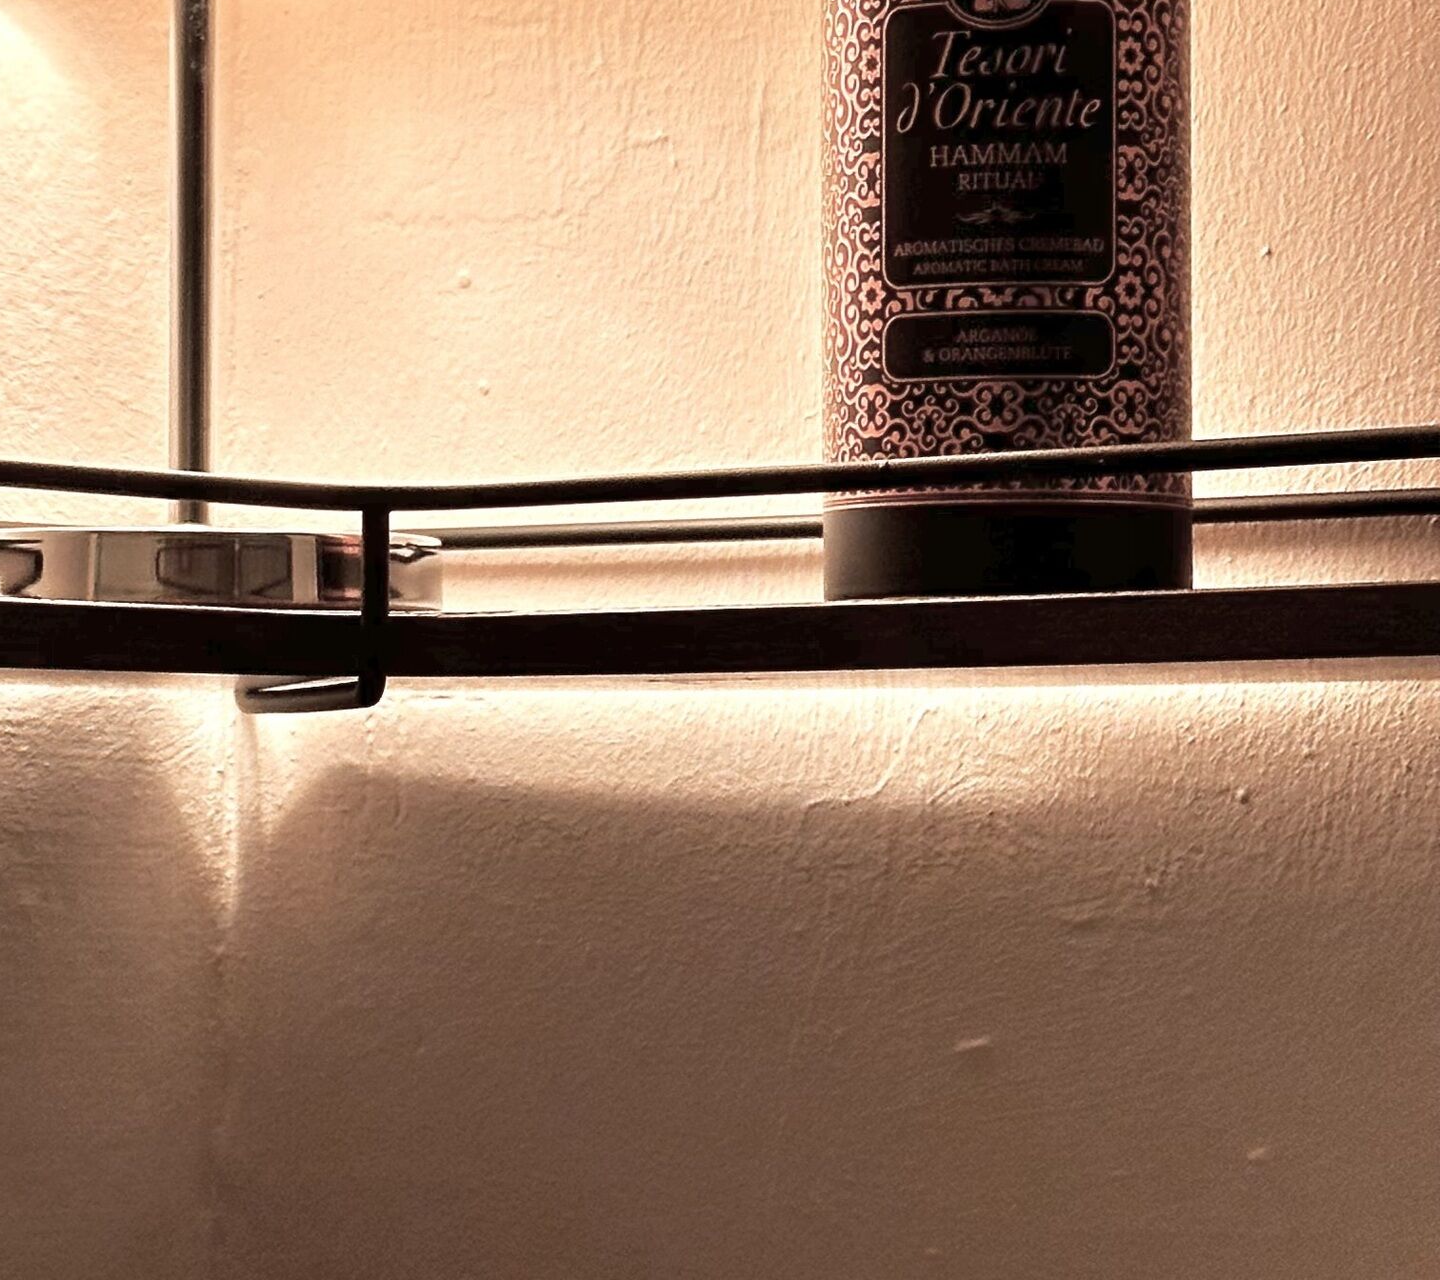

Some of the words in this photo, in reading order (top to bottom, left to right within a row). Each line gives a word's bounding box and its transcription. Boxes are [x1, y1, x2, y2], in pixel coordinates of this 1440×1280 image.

[929, 27, 1072, 80] Tesori
[896, 81, 1102, 134] d'Oriente
[929, 141, 1068, 168] HAMMAM
[912, 260, 988, 276] AROMATIC
